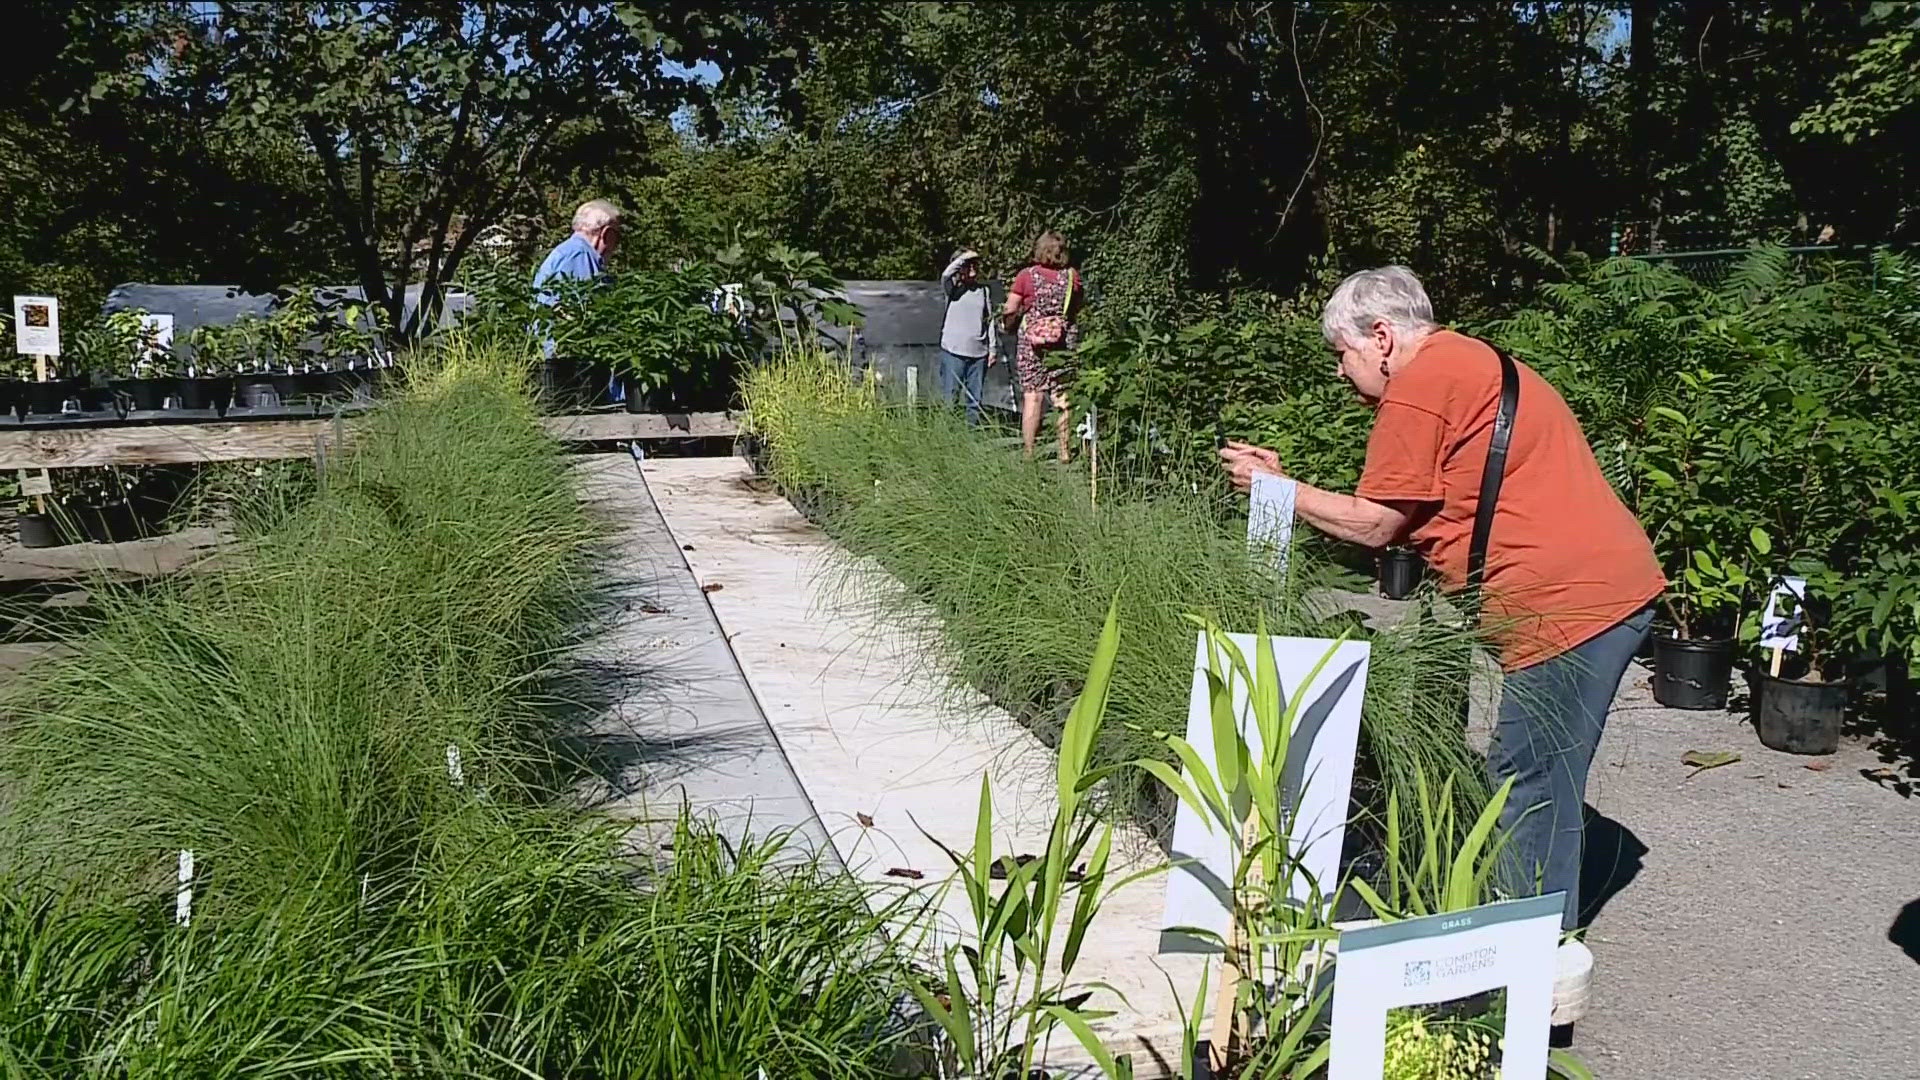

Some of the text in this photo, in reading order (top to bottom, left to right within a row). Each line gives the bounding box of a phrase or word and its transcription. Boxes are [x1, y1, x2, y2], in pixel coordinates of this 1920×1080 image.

[1441, 916, 1473, 930] GRASS
[1435, 945, 1497, 968] COMPTON
[1435, 957, 1496, 978] GARDENS
